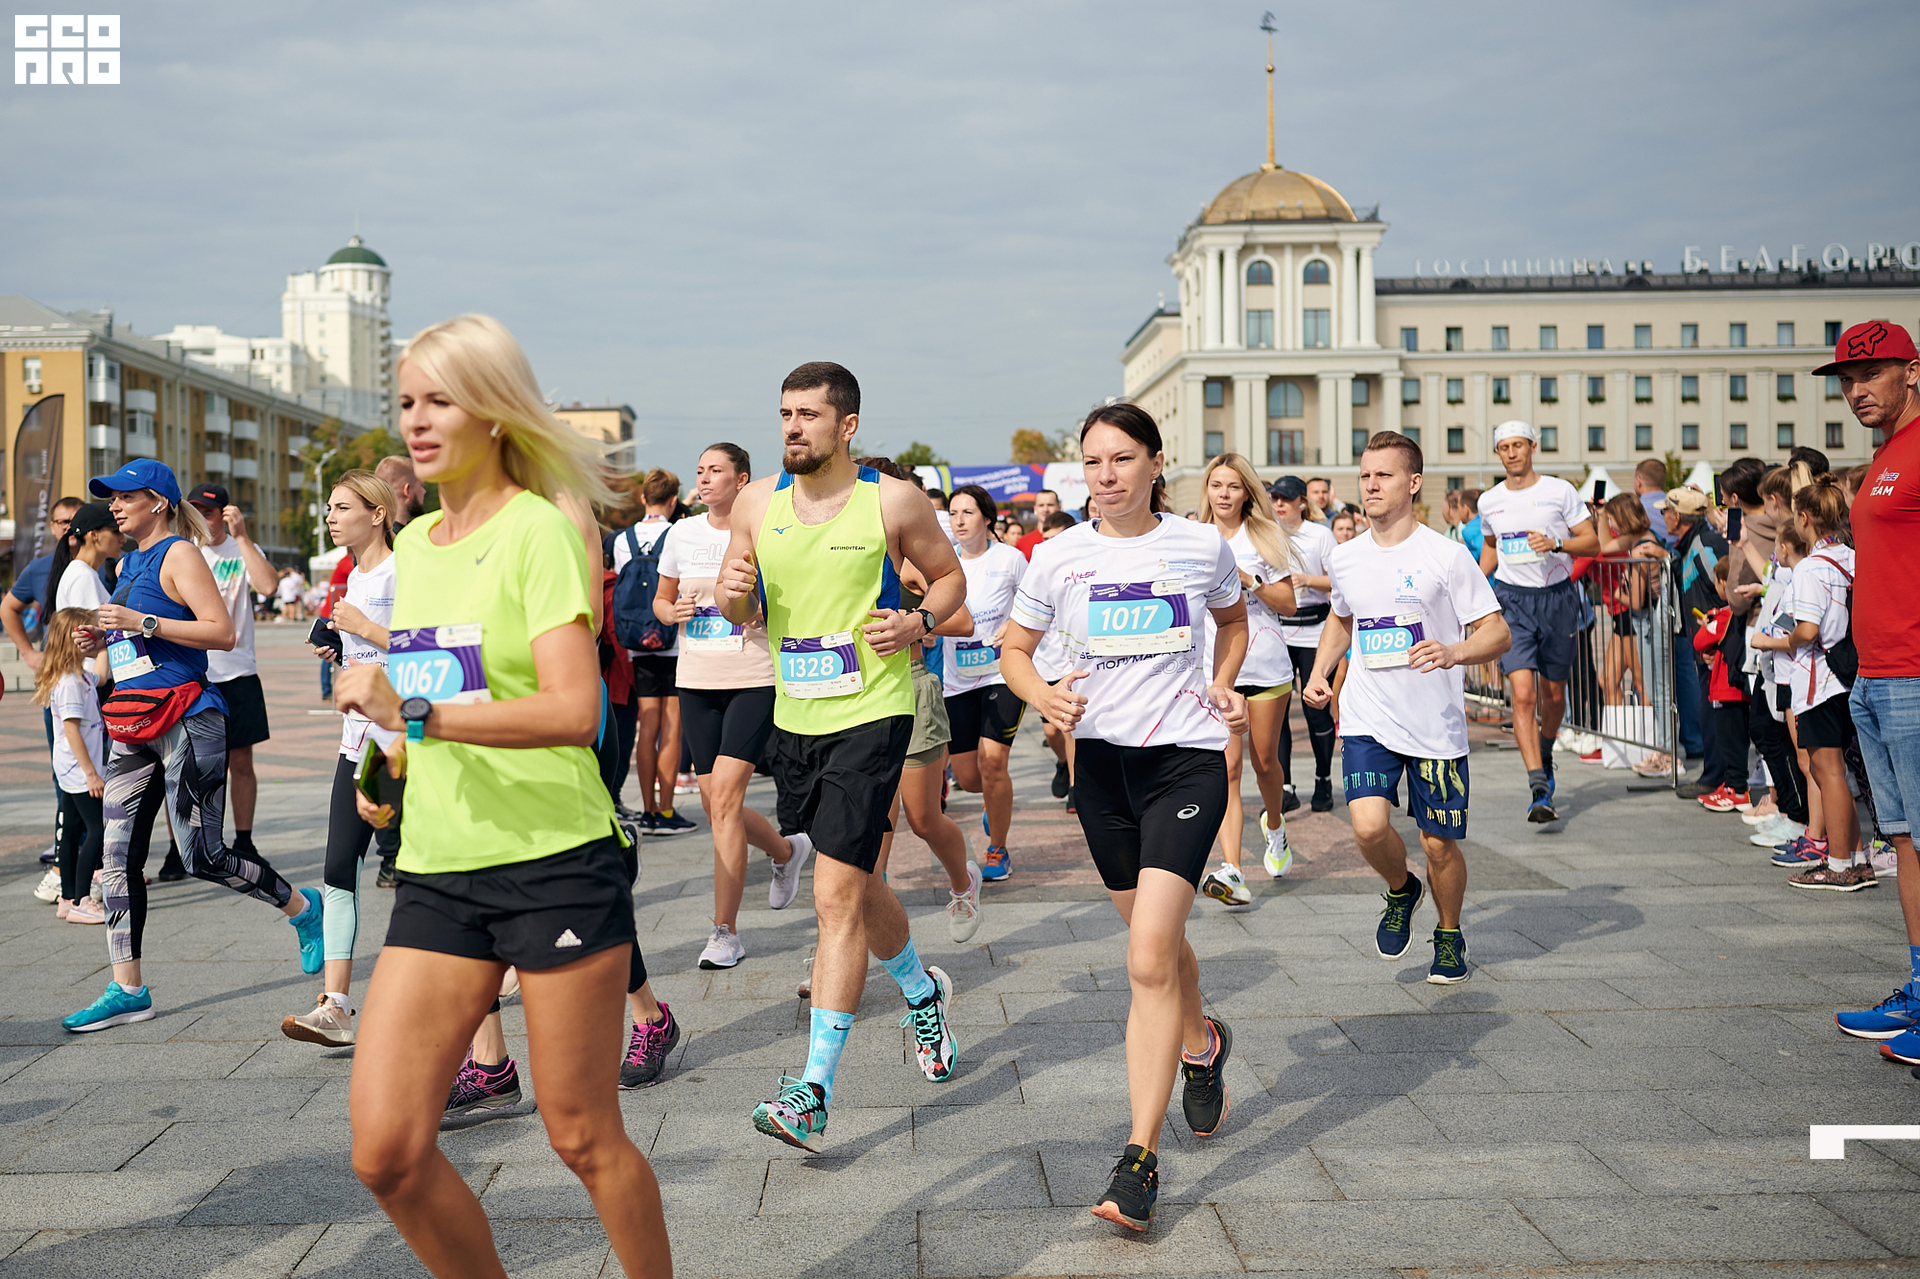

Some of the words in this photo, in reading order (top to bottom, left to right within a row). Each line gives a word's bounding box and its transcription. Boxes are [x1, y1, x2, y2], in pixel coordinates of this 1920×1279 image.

[1416, 258, 1613, 276] ГОСТИНИЦА
[1101, 604, 1159, 631] 1017
[692, 620, 723, 636] 1129
[1365, 631, 1406, 651] 1098
[111, 644, 131, 665] 1352
[961, 651, 987, 665] 1135
[395, 658, 452, 695] 1067
[788, 655, 834, 678] 1328
